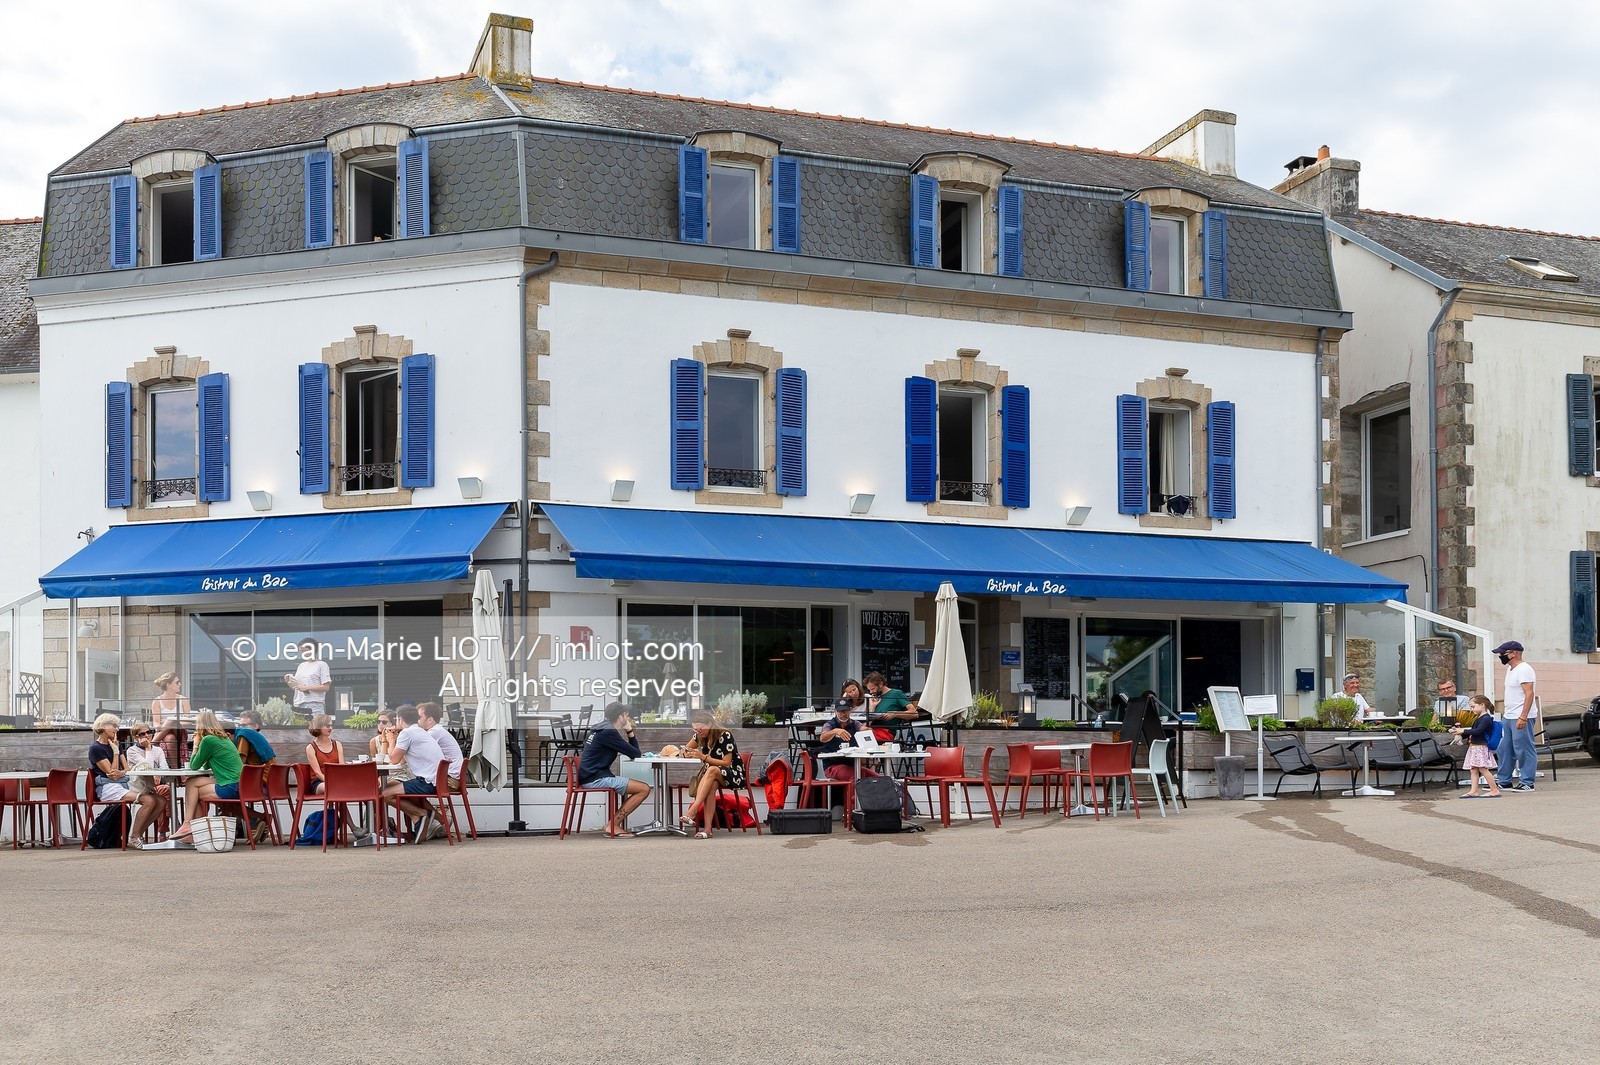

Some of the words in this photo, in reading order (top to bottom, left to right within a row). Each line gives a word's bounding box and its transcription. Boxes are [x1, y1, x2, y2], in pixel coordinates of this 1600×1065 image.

[201, 576, 240, 591] Bistrot
[242, 576, 258, 590] du
[261, 573, 289, 589] Bac
[986, 578, 1022, 593] Bistrot
[1024, 581, 1039, 594] du
[1042, 580, 1067, 594] Bac
[862, 611, 881, 626] HOTEL
[882, 611, 909, 627] BISTROT
[871, 628, 882, 641] DU
[884, 628, 903, 642] BAC
